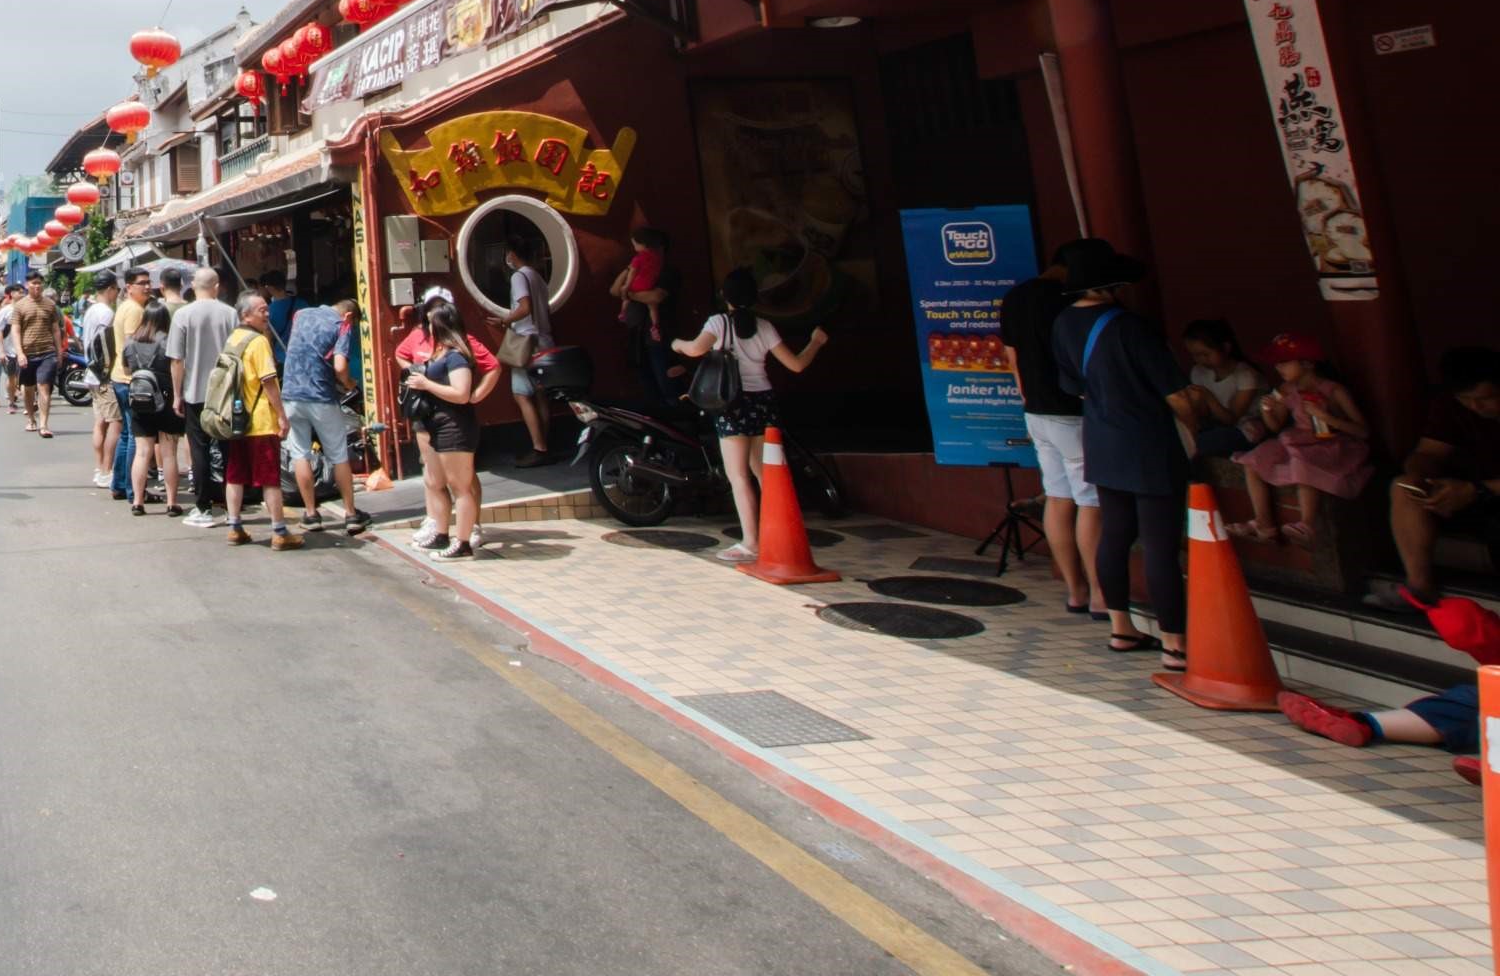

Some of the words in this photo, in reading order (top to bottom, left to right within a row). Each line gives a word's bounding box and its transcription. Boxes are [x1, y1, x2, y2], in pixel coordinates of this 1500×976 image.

[360, 28, 405, 76] KACIP
[352, 194, 366, 264] NASI
[946, 229, 989, 240] Touch
[358, 274, 371, 338] AYAM
[919, 299, 949, 309] Spend
[949, 299, 992, 307] minimum
[925, 310, 959, 319] Touch
[973, 310, 989, 319] Go
[946, 383, 995, 397] Jonker
[995, 384, 1020, 396] Wa
